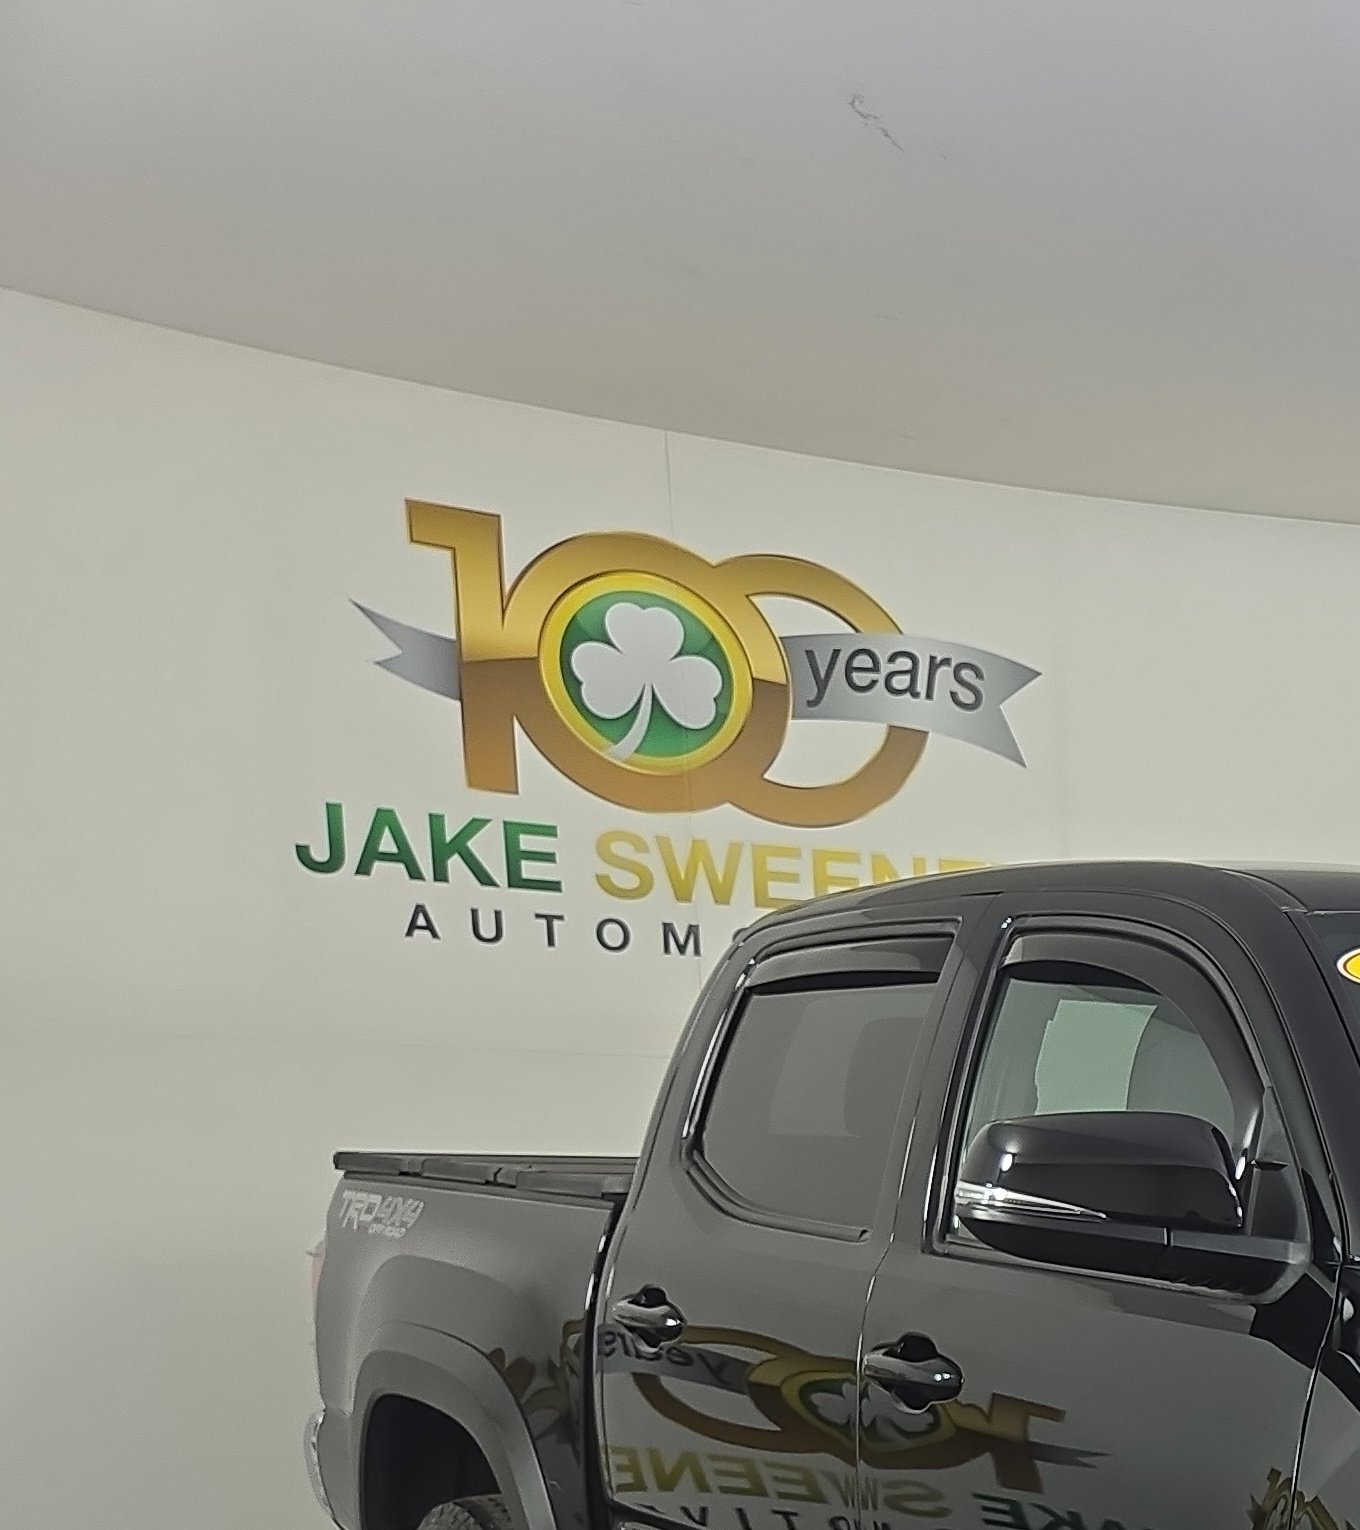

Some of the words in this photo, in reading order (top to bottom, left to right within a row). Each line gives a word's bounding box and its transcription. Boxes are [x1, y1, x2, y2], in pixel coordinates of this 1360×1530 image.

[404, 498, 928, 828] 100
[803, 641, 985, 711] years
[295, 802, 562, 893] JAKE
[595, 830, 988, 910] SWEE
